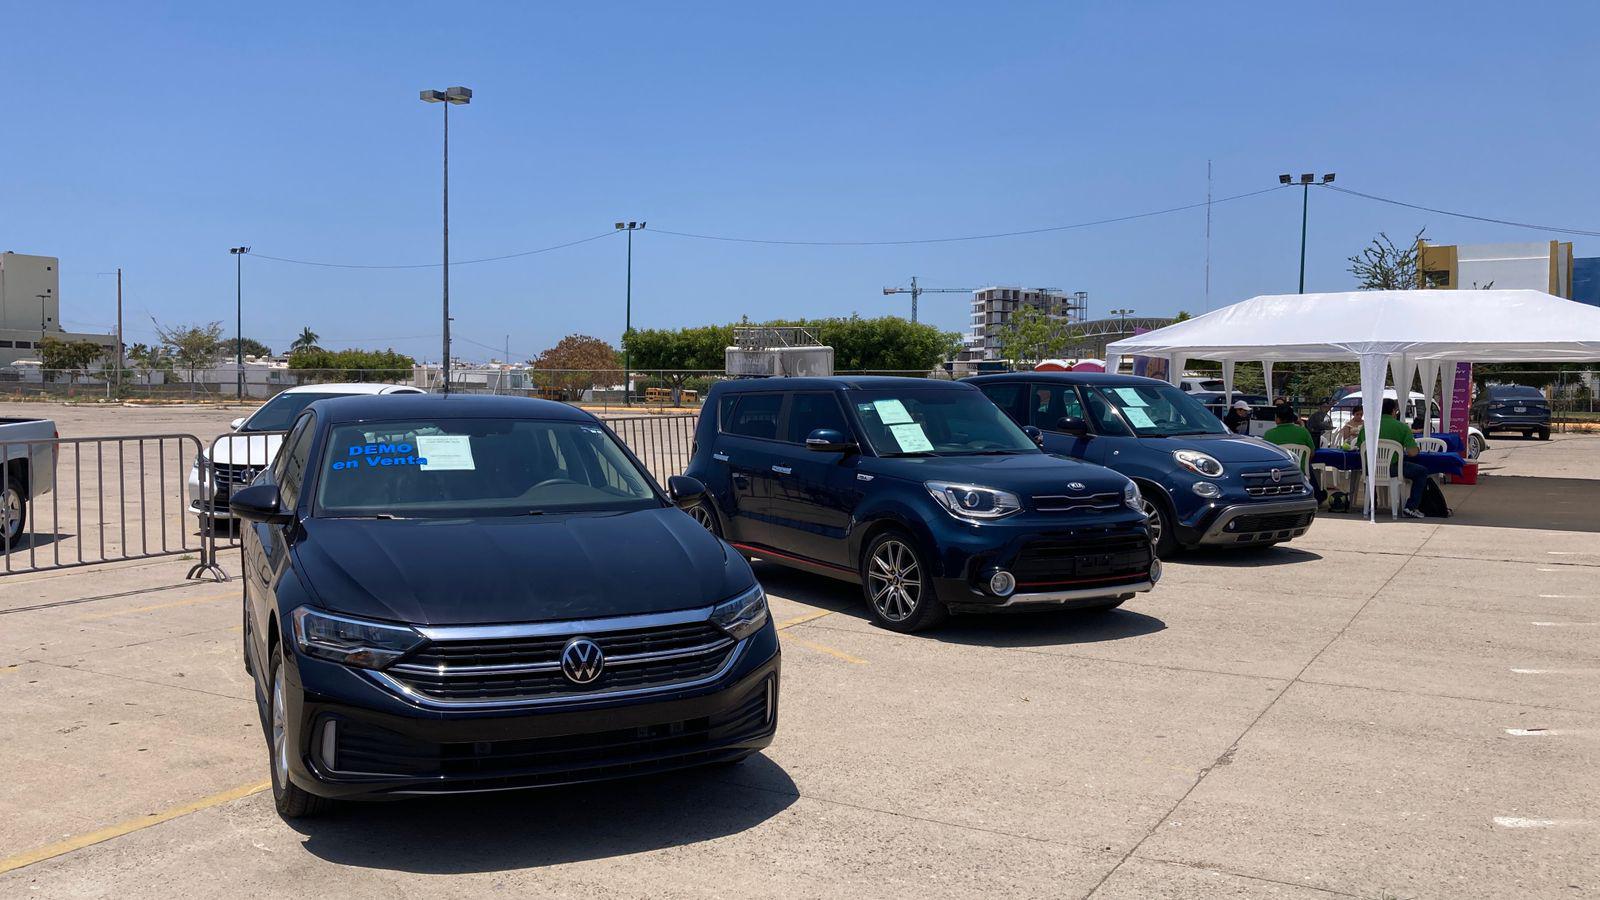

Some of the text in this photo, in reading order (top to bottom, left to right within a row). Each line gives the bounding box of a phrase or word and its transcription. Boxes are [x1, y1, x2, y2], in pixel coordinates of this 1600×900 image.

[349, 443, 413, 456] DEMO
[332, 459, 359, 471] en
[365, 455, 428, 467] Venta
